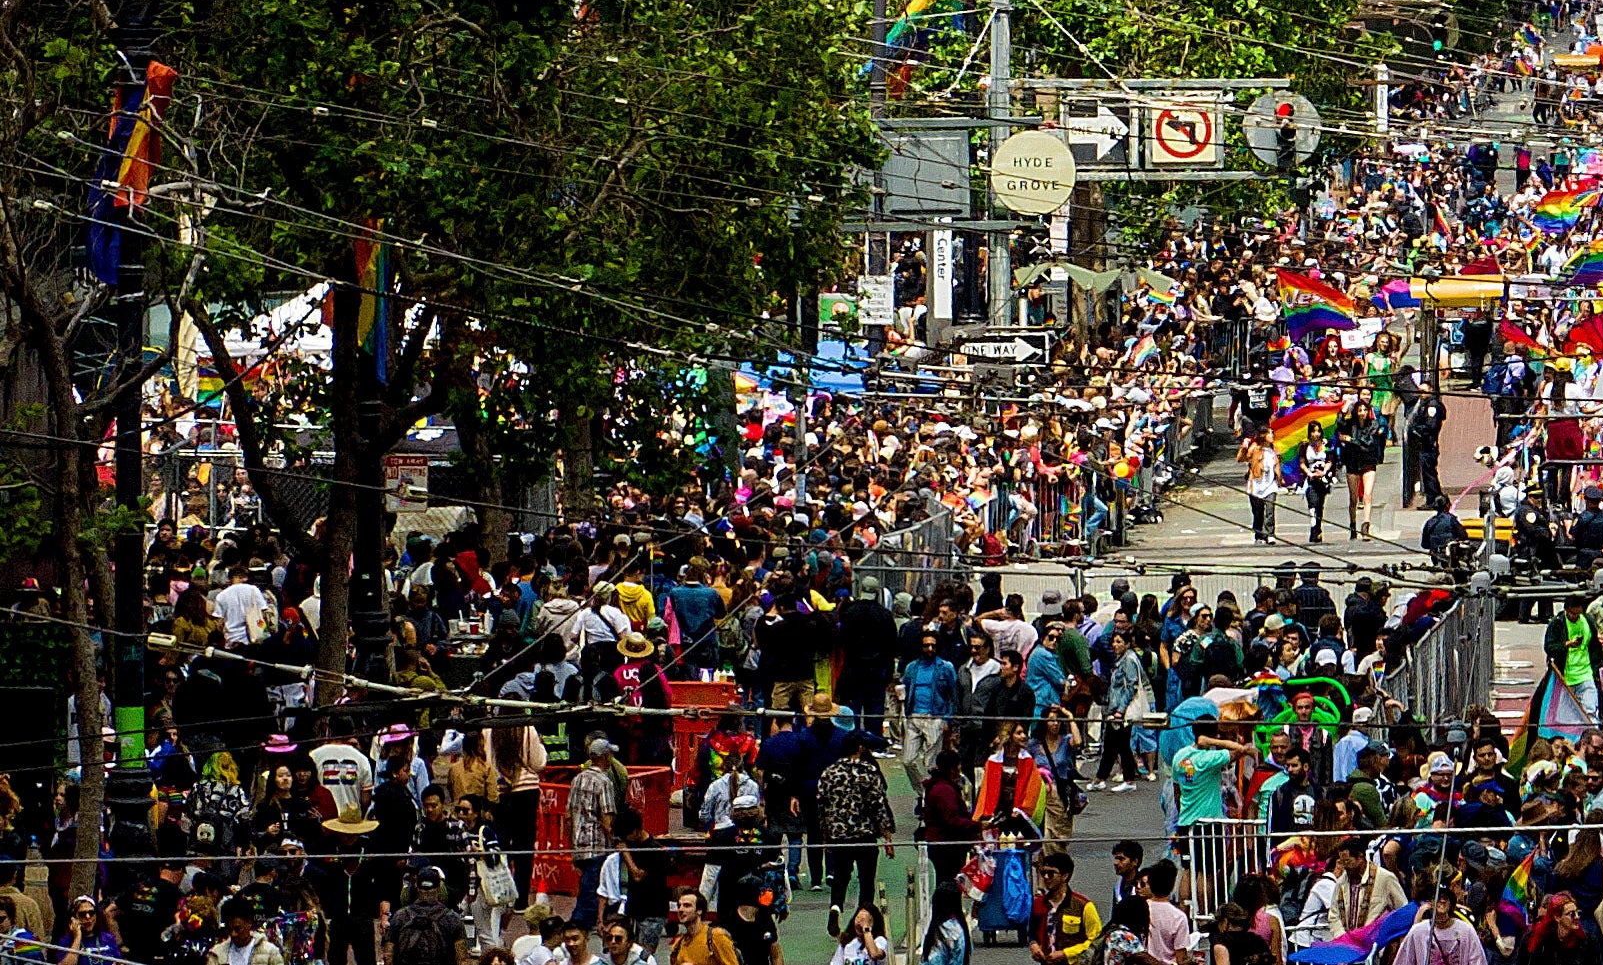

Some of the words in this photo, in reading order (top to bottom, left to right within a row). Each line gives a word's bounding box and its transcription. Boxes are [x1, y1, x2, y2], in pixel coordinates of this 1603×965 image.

[1072, 125, 1092, 135] ONE
[1013, 157, 1054, 168] HYDE
[1007, 180, 1060, 191] GROVE
[936, 237, 948, 281] Center
[963, 345, 985, 355] ONE
[993, 345, 1017, 355] WAY
